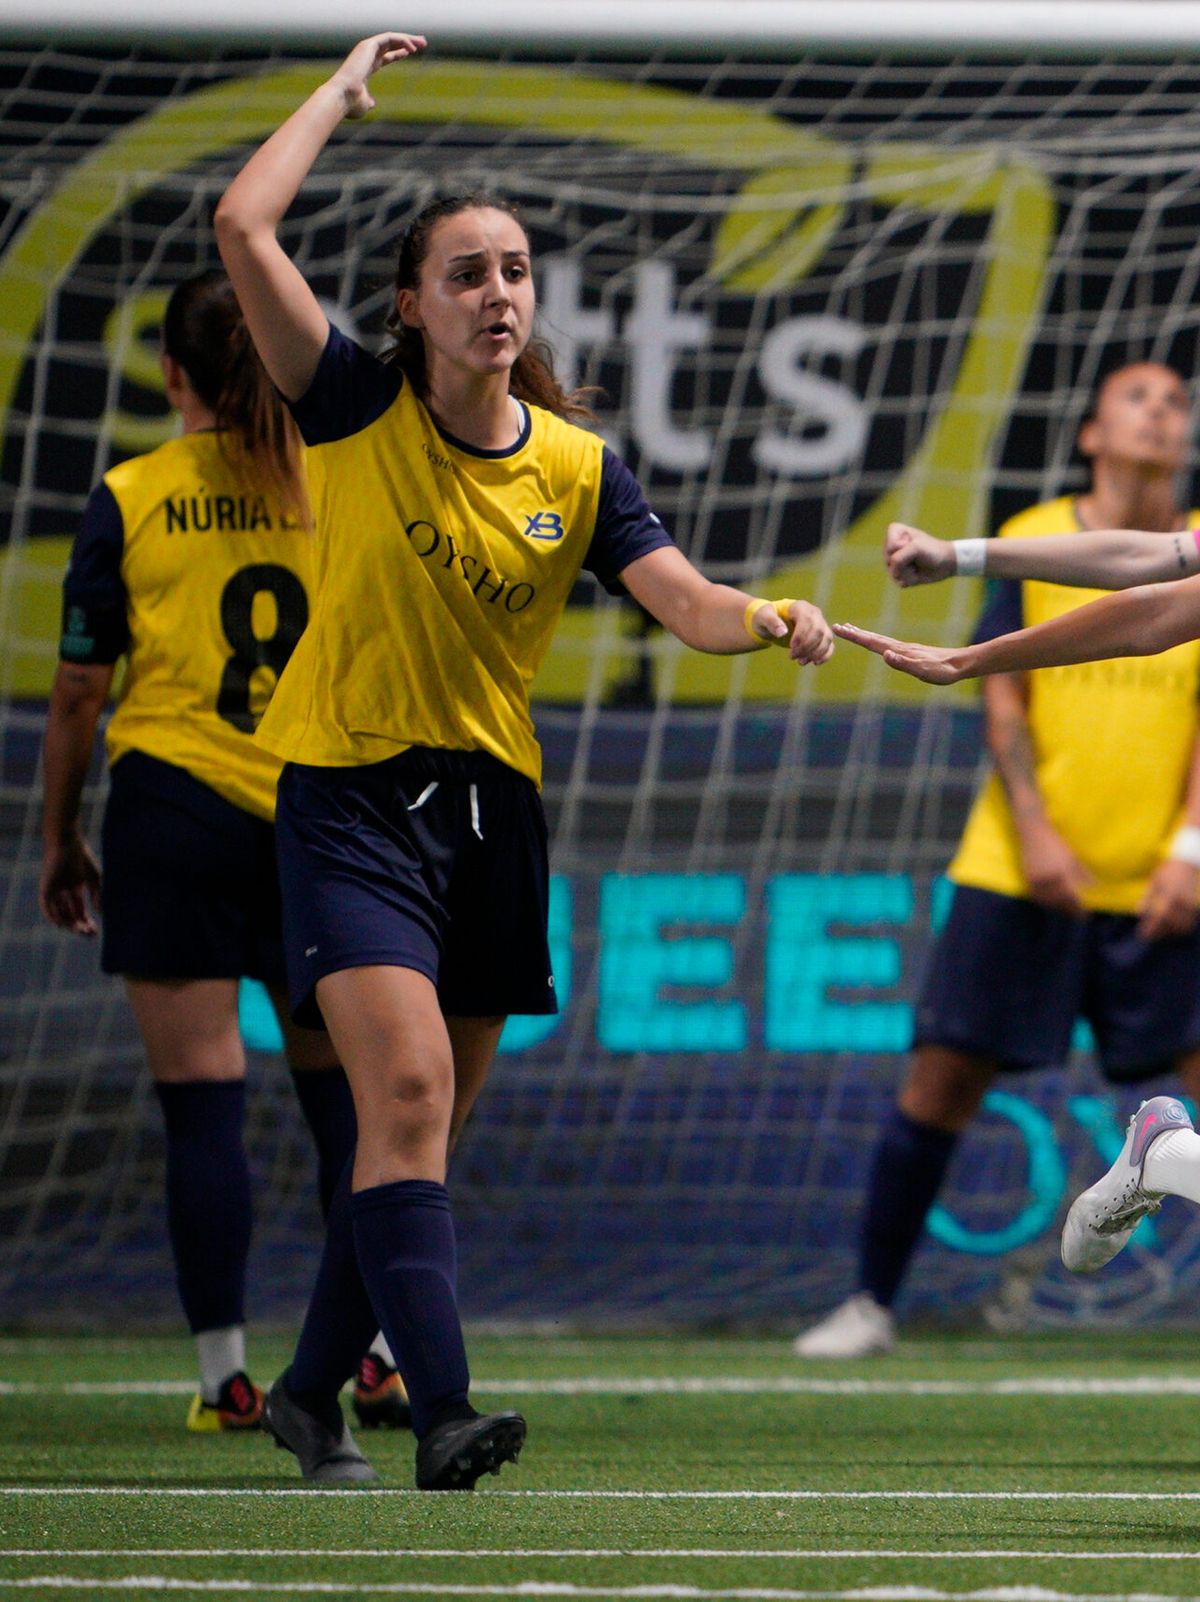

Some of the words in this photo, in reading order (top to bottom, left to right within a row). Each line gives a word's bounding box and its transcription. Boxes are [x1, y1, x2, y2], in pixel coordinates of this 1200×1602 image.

[164, 485, 273, 535] NÚRIA
[406, 519, 536, 613] OYSHO
[215, 562, 310, 736] 8
